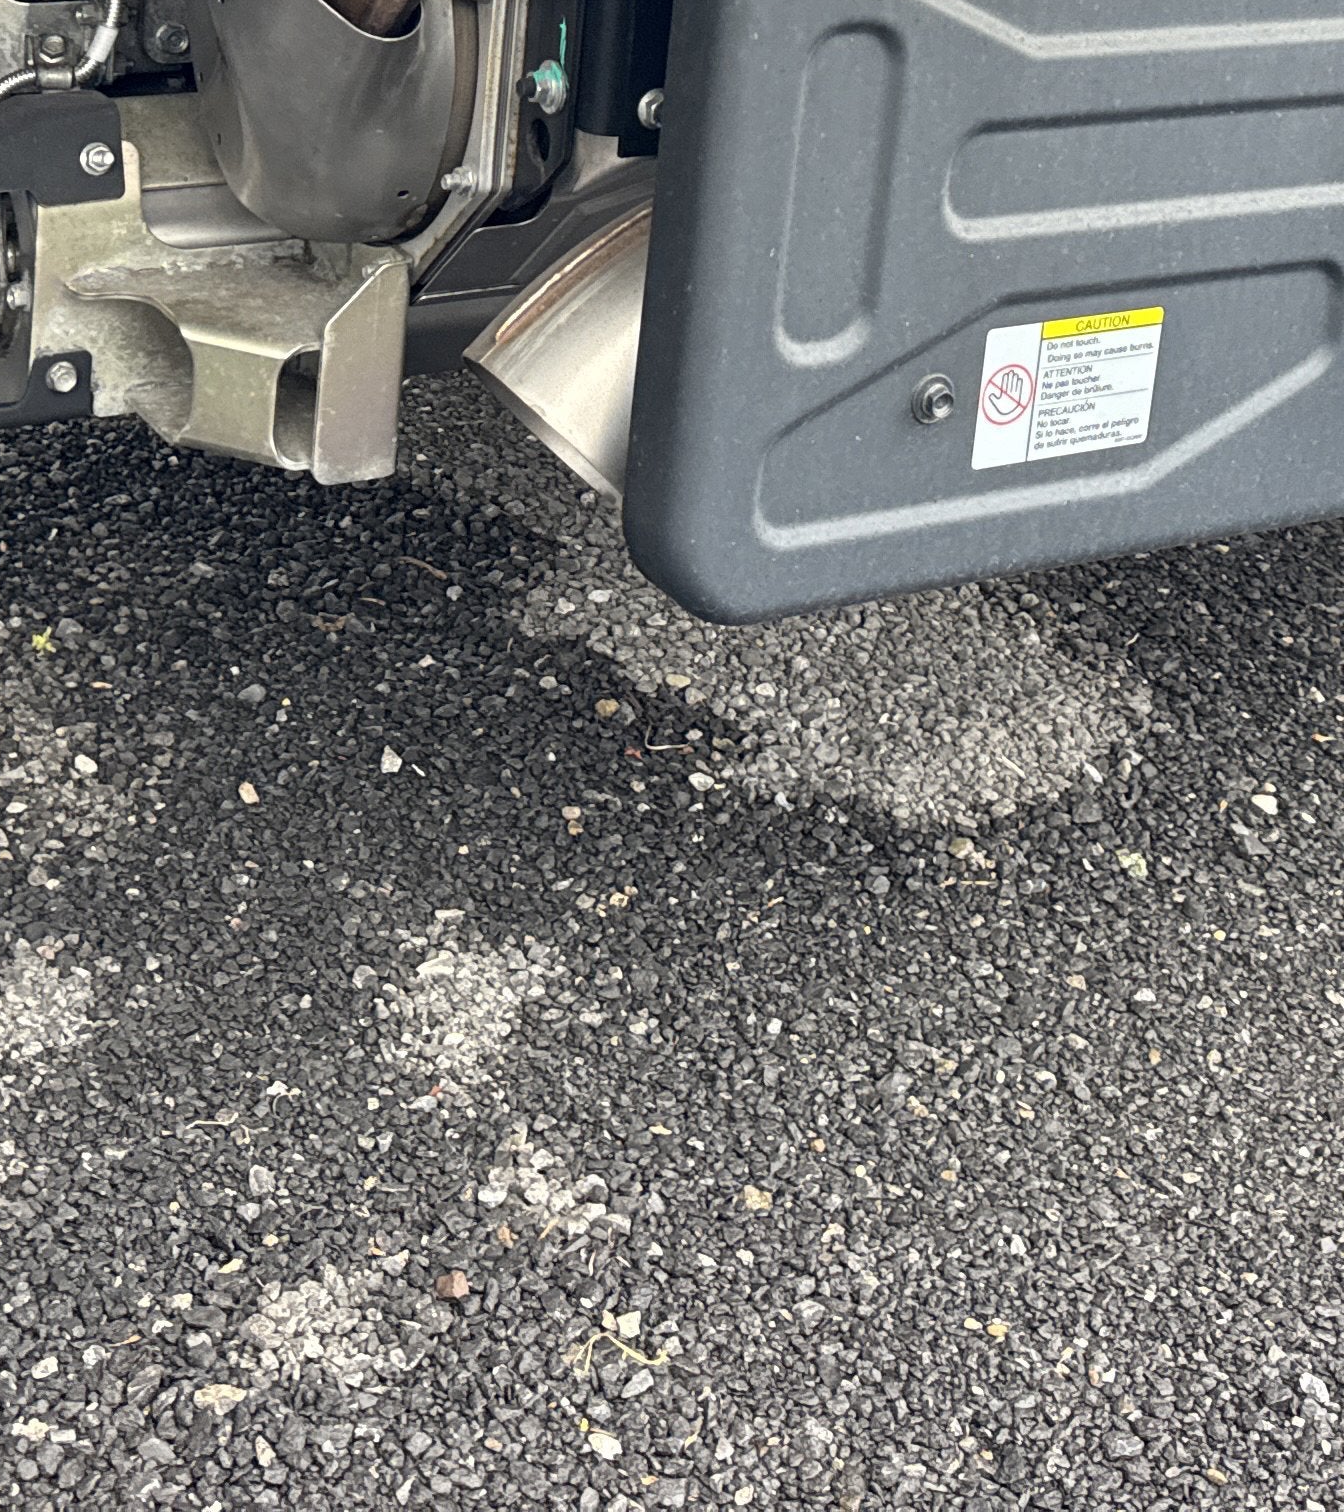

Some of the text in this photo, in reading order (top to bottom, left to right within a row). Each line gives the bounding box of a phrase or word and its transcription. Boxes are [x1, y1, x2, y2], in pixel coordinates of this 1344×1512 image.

[1076, 315, 1131, 332] CAUTION
[1046, 336, 1101, 351] Do not touch.
[1047, 342, 1154, 364] Doing so may cause burns.
[1042, 364, 1093, 380] ATTENTION
[1041, 381, 1053, 390] Ne
[1055, 380, 1070, 389] pas
[1040, 389, 1071, 401] Danger
[1072, 387, 1083, 396] de
[1037, 399, 1096, 418] PRECAUCIÓN
[1035, 430, 1044, 440] Si
[1044, 429, 1054, 438] lo
[1078, 422, 1101, 433] corre
[1101, 420, 1110, 430] el
[1110, 417, 1140, 430] peligro
[1036, 420, 1048, 430] No
[1033, 441, 1045, 451] de
[1046, 437, 1069, 449] sufrir
[1069, 430, 1123, 445] quemaduras.
